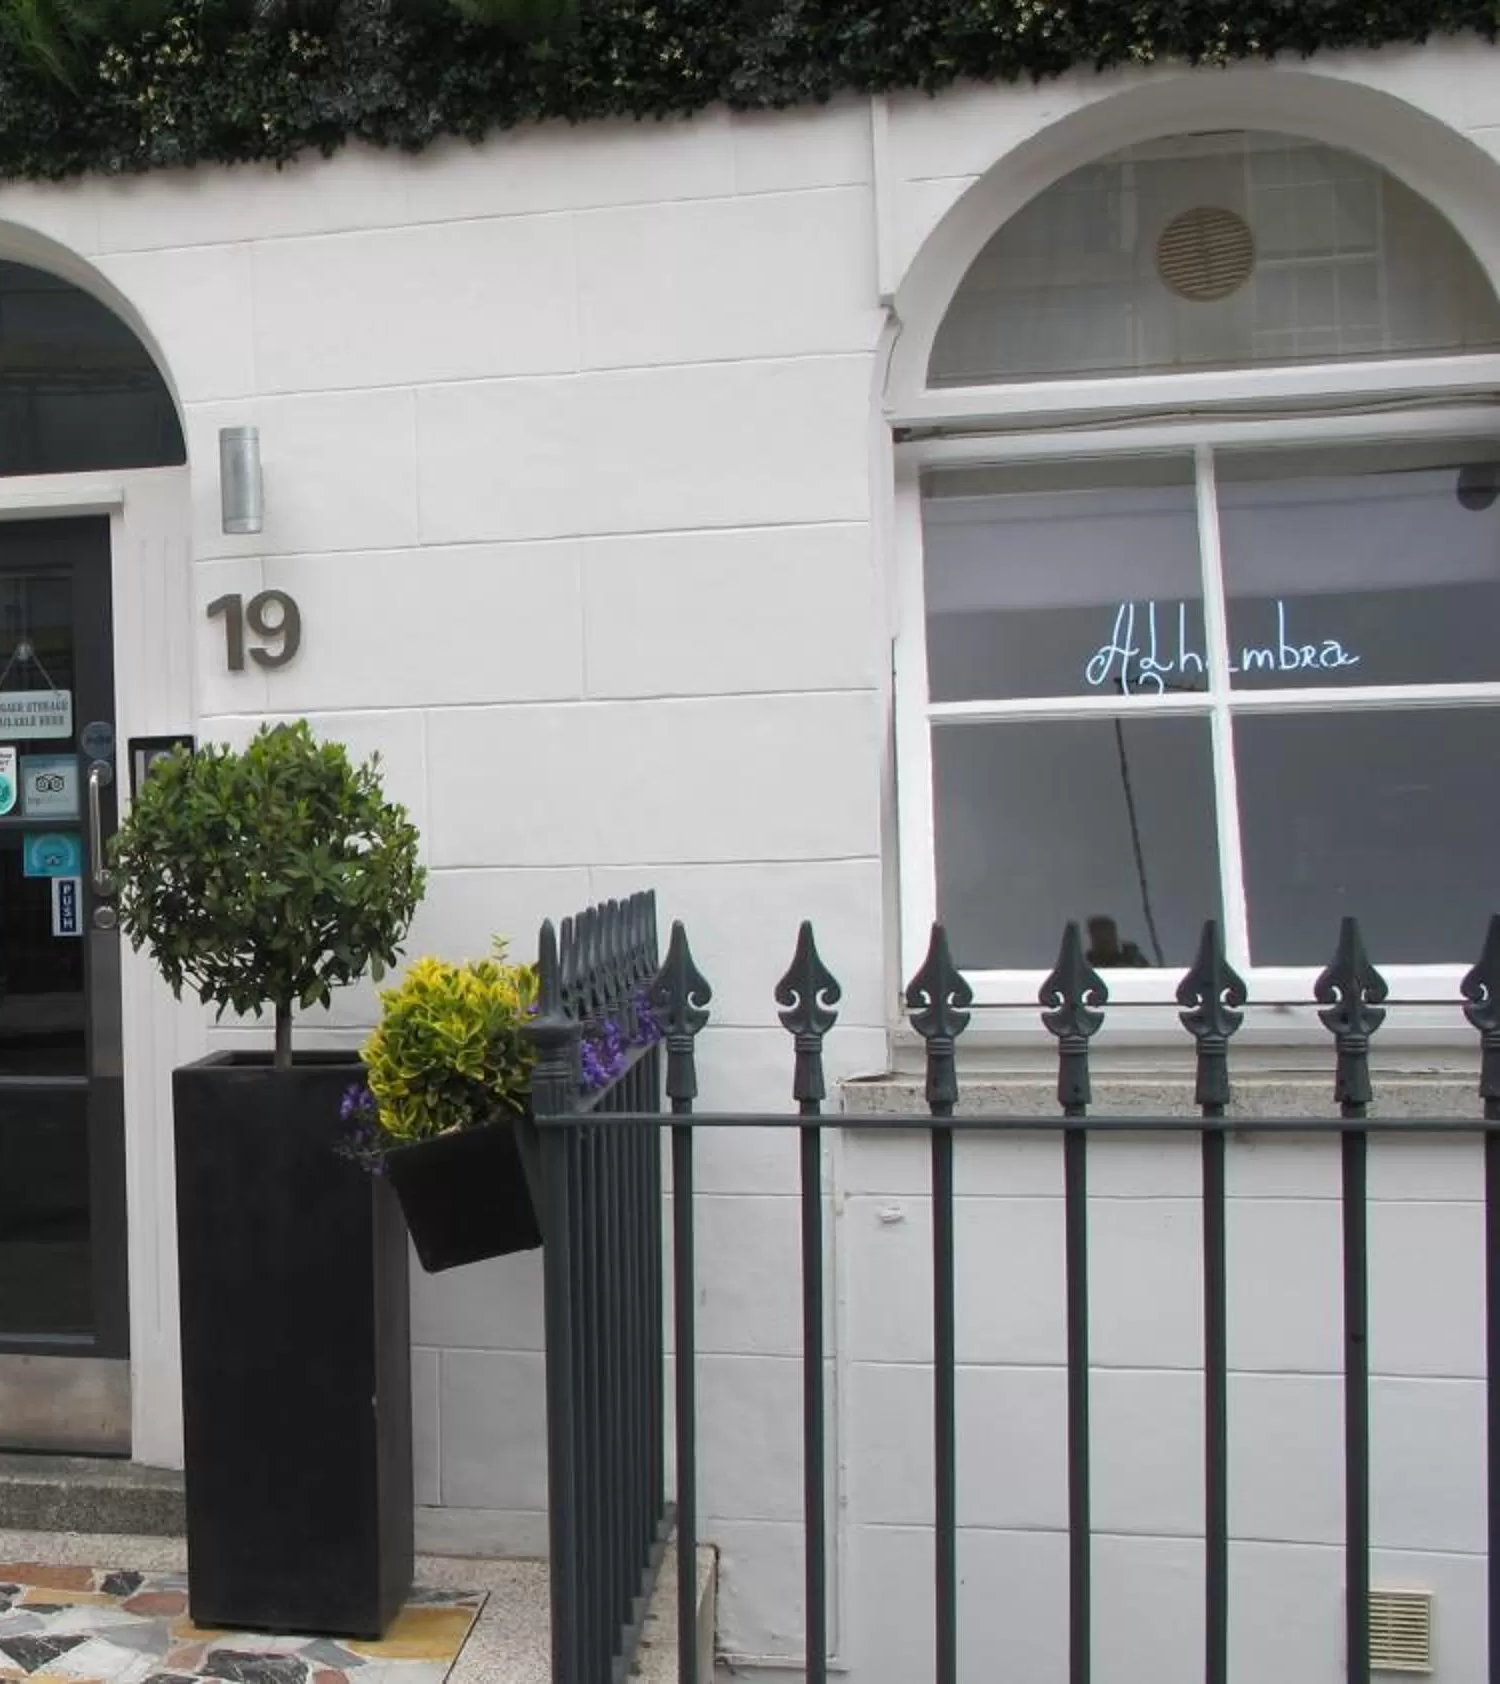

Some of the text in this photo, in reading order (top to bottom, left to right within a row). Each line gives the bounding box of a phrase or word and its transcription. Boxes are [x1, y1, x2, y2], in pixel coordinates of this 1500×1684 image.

[206, 589, 301, 671] 19
[1086, 600, 1360, 697] Alhmbra
[62, 883, 73, 930] PUSH
